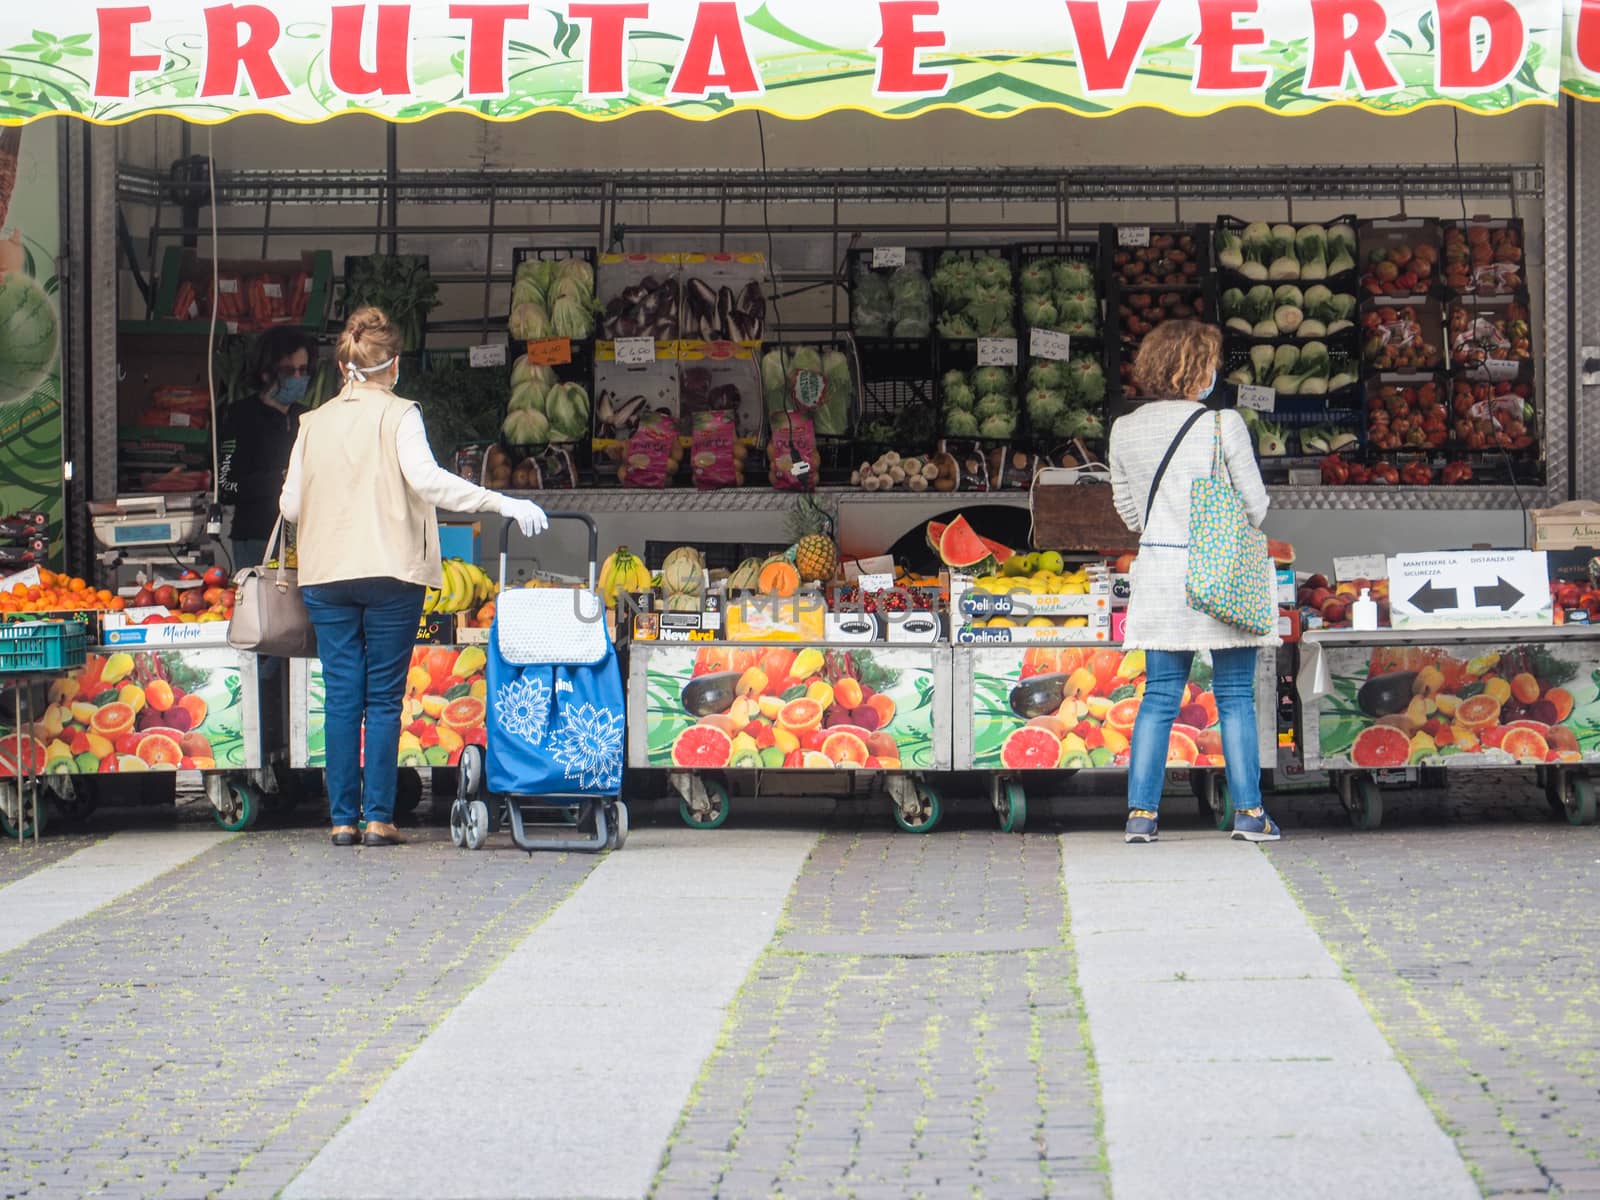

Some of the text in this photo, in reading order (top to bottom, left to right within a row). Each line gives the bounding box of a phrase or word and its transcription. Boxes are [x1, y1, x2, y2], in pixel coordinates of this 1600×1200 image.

[95, 3, 760, 98] FRUTTA
[874, 0, 950, 92] E
[1402, 559, 1447, 568] MANTENERE
[1404, 569, 1441, 577] SICUREZZA
[961, 597, 1011, 612] Melinda
[163, 625, 200, 643] Marlene
[959, 631, 1011, 642] Melinda
